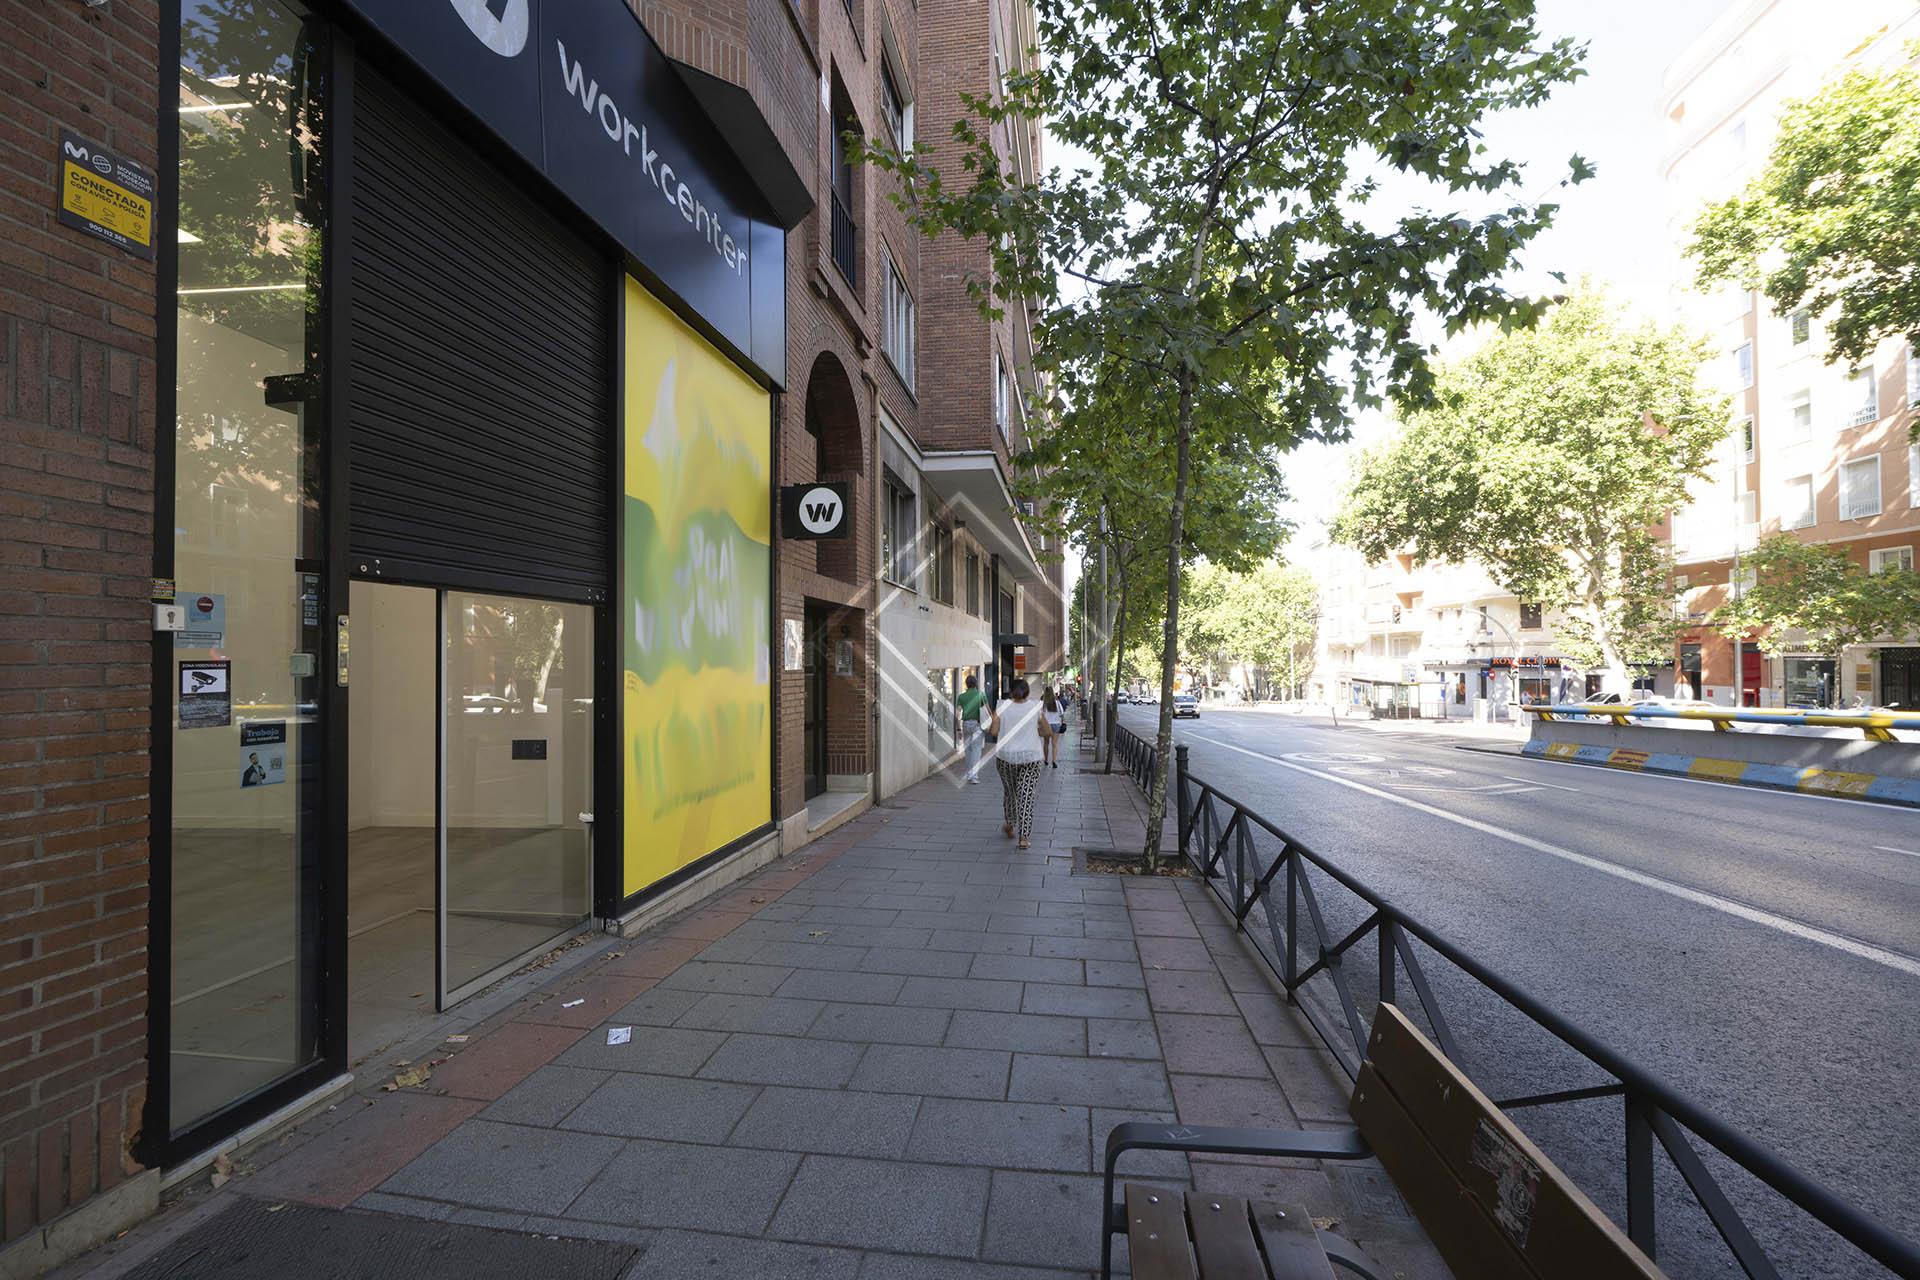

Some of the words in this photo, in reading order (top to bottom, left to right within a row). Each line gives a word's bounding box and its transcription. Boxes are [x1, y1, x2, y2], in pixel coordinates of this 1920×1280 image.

[557, 38, 748, 277] workcenter
[117, 164, 150, 185] MOVISTAR
[117, 170, 153, 192] PROSEGUR
[71, 171, 146, 212] CONECTADA
[71, 180, 88, 192] CON
[88, 188, 112, 204] AVISO
[89, 222, 103, 233] 900
[103, 229, 114, 238] 112
[1492, 657, 1526, 665] ROYL
